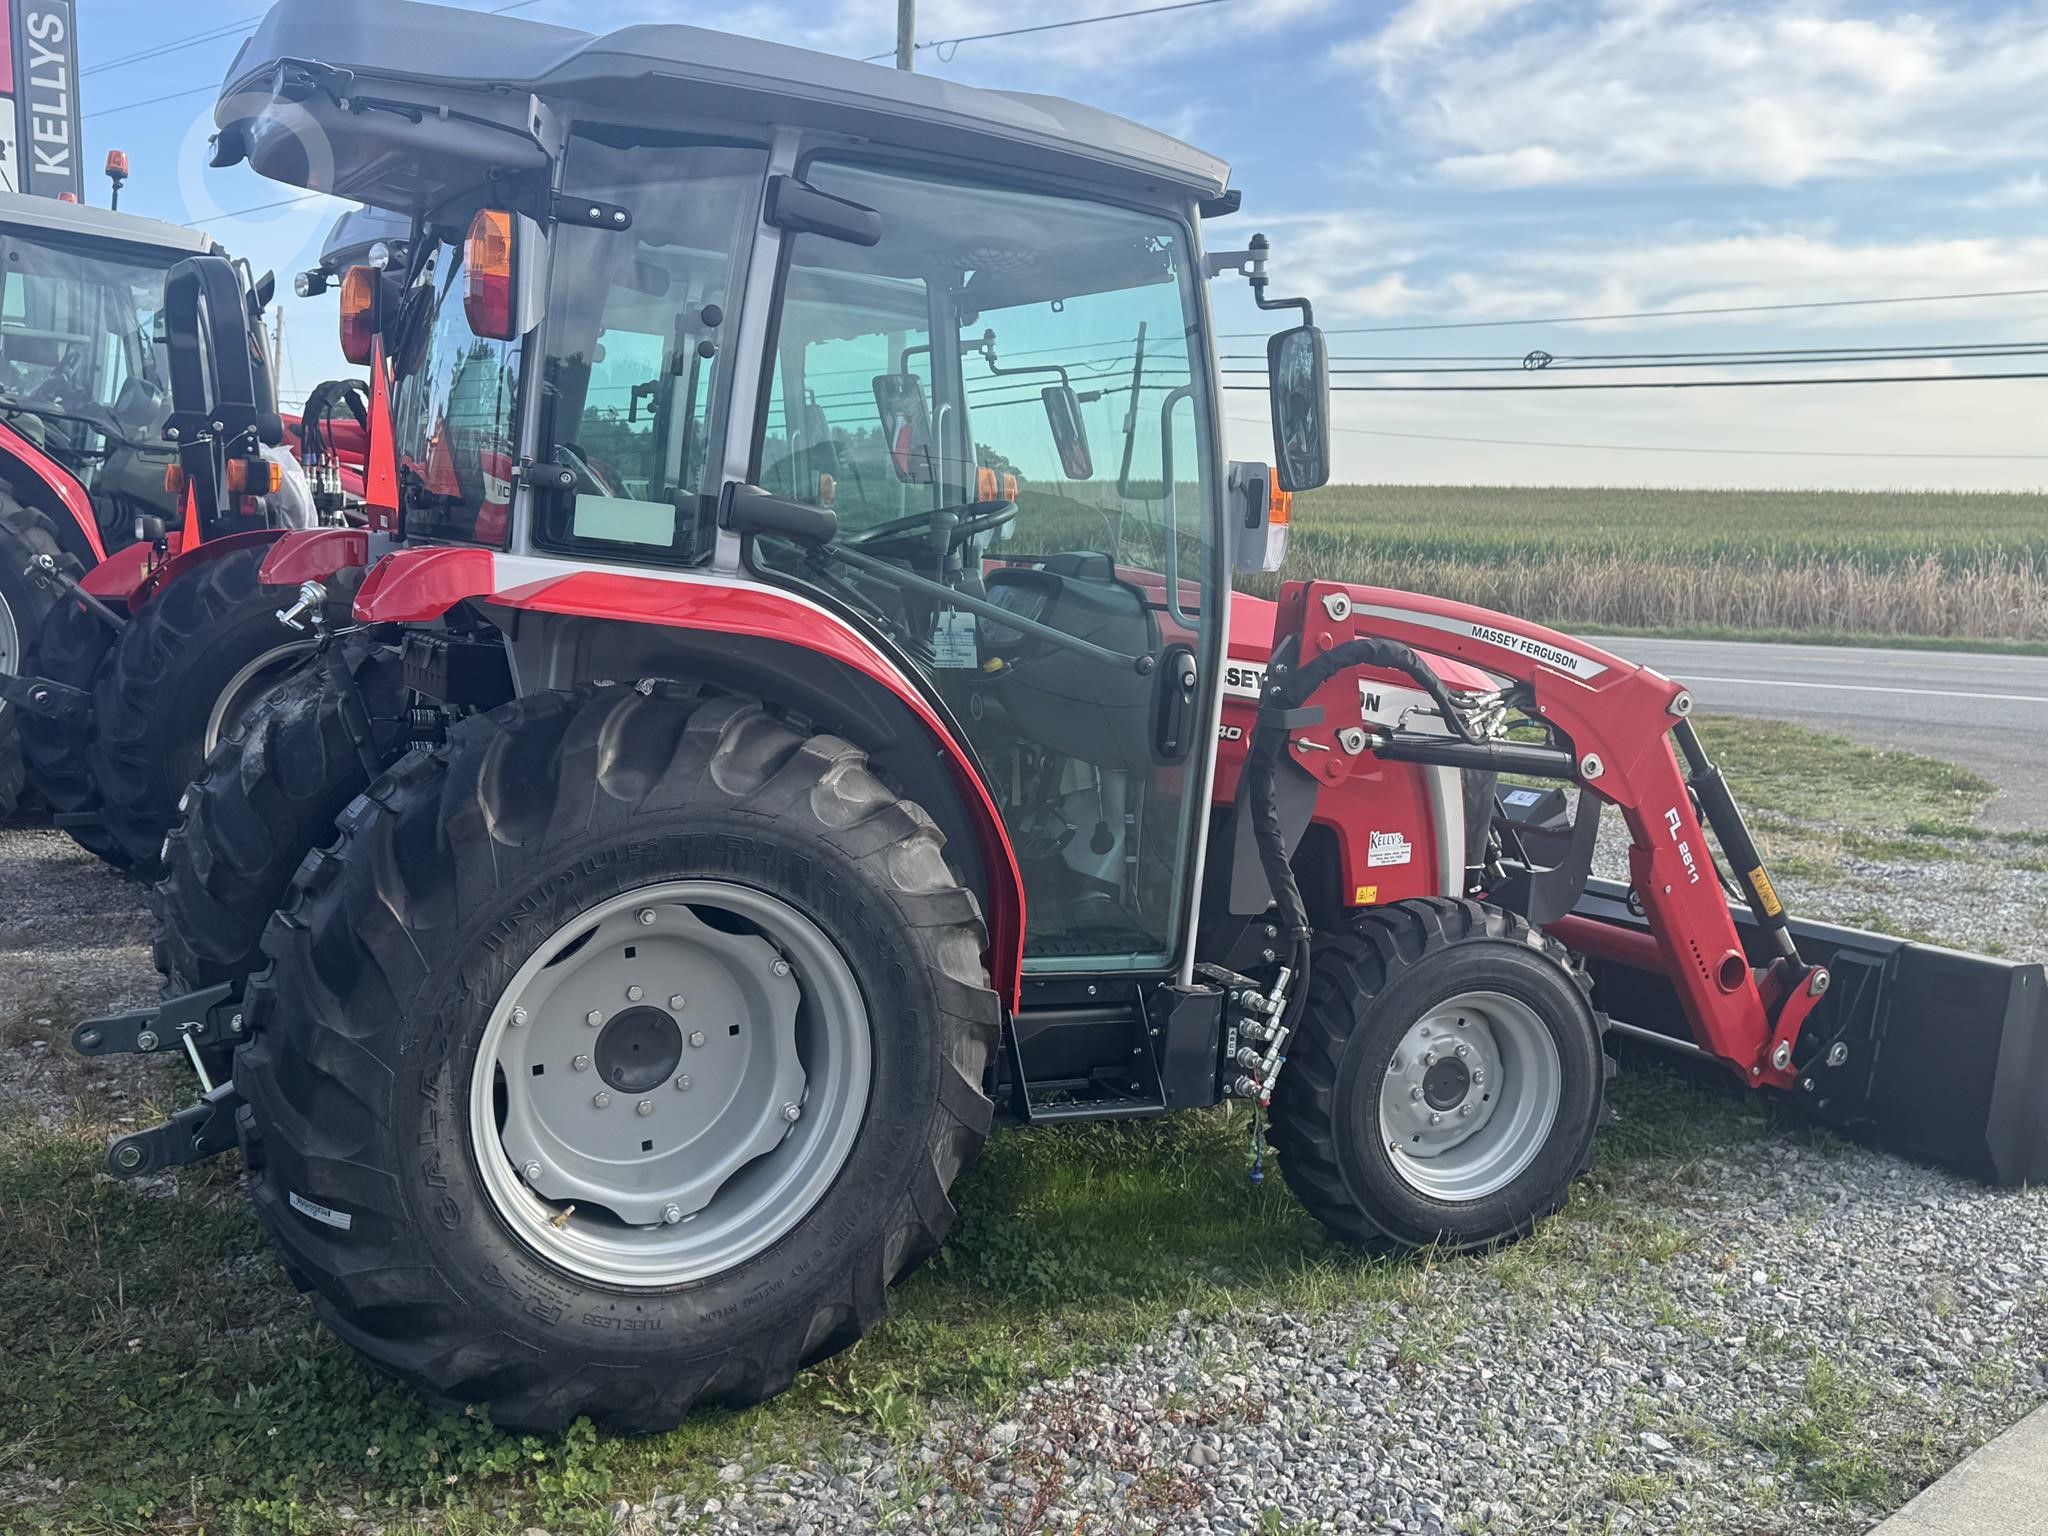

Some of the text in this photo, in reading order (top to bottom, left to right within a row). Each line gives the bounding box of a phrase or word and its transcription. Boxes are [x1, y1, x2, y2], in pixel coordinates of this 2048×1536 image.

[27, 12, 70, 176] KELLYS
[1471, 625, 1578, 670] MASSEY FERGUSON
[1225, 667, 1267, 690] SEY
[1664, 806, 1700, 884] FL 2611
